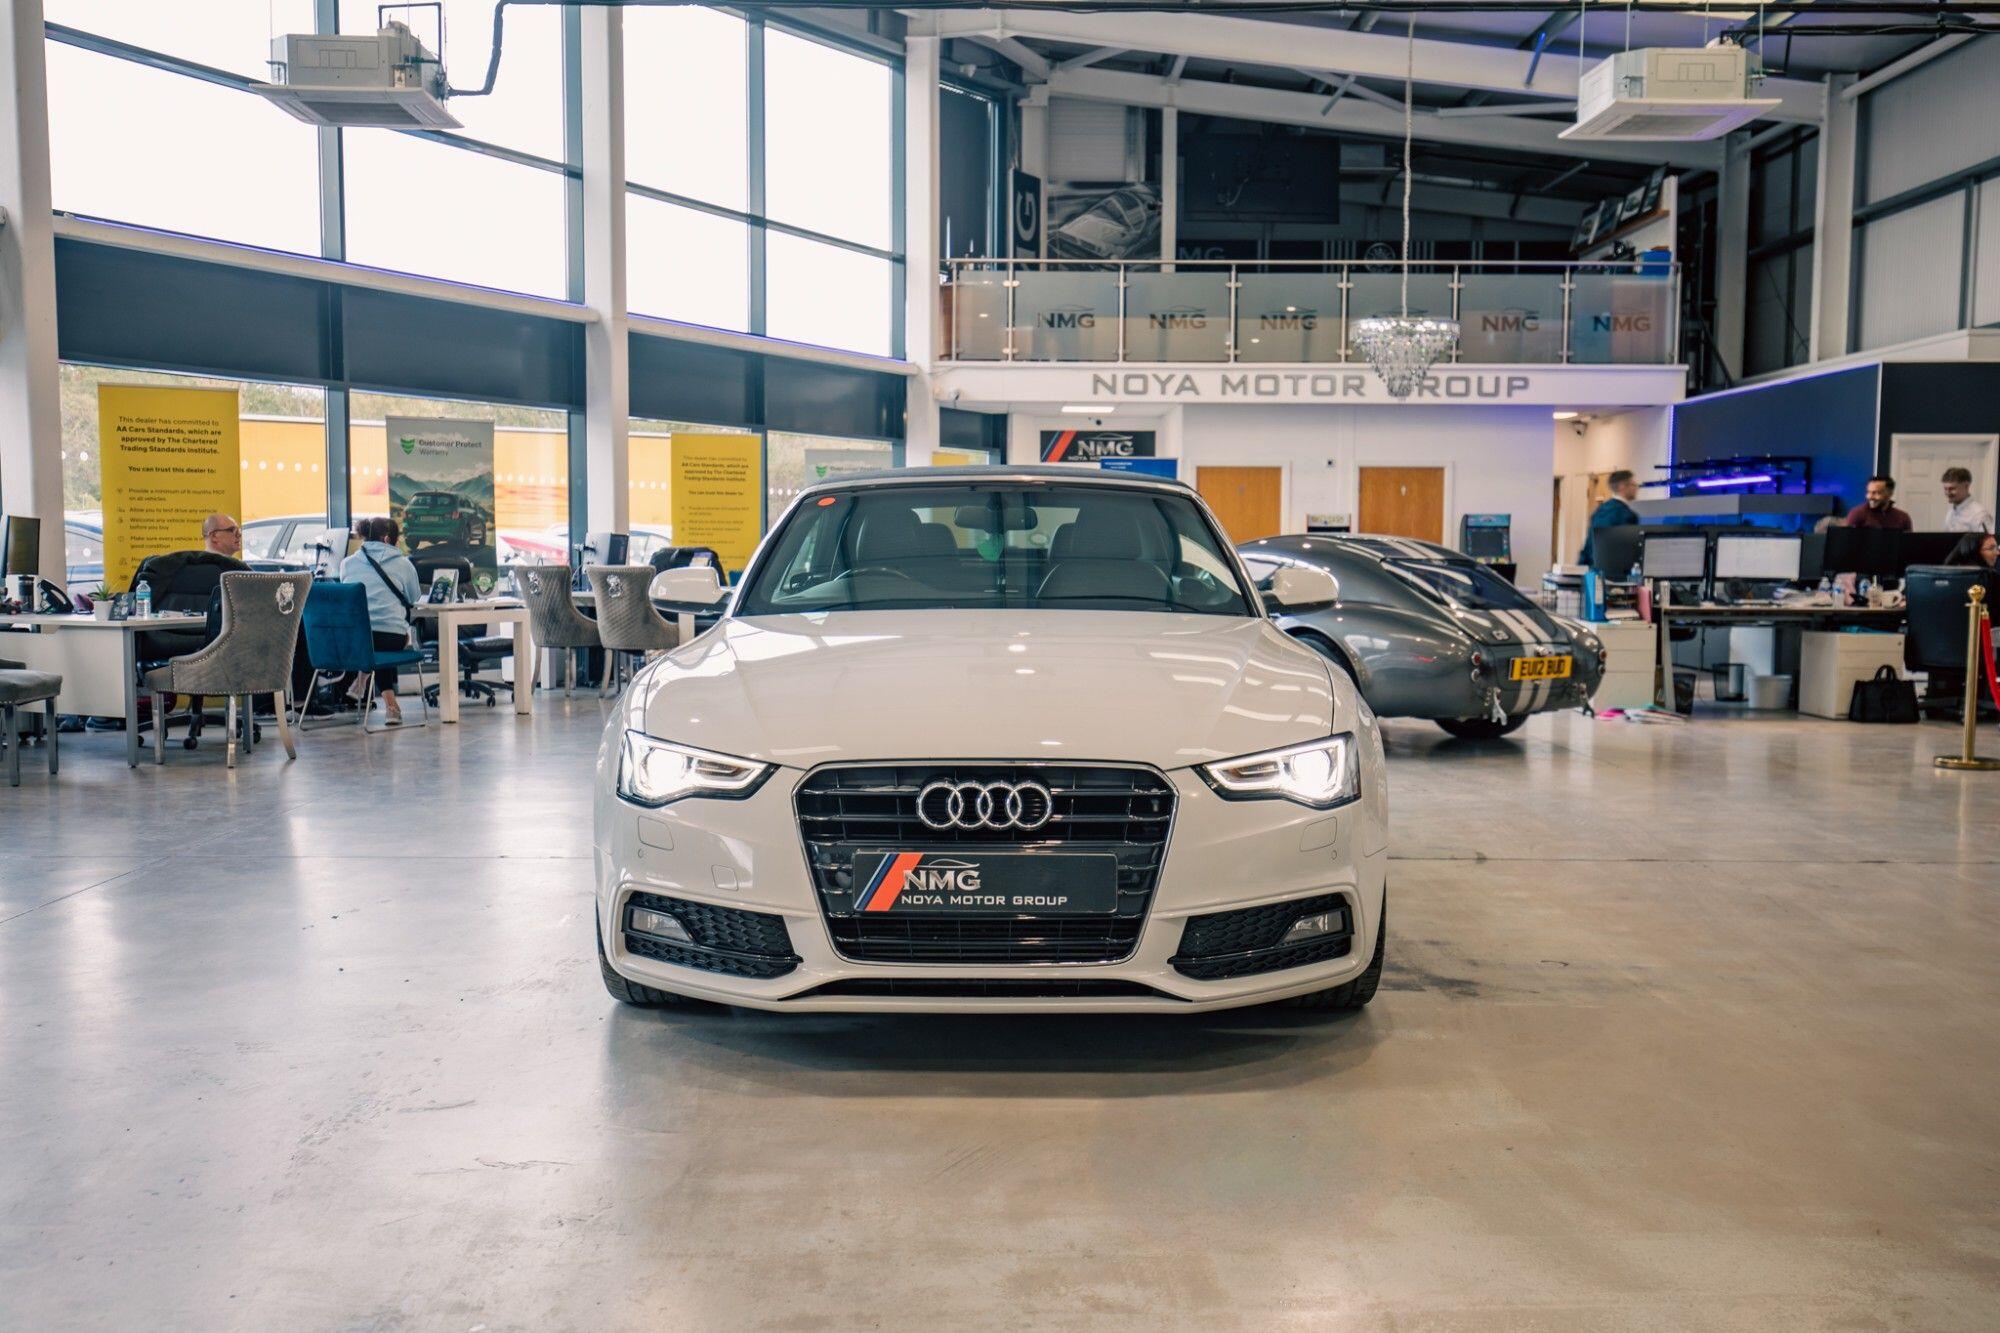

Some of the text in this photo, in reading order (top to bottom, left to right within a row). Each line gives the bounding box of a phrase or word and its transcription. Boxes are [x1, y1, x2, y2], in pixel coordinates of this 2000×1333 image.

[1149, 313, 1206, 329] NMG
[1260, 314, 1317, 330] NMG
[1482, 315, 1540, 332] NMG
[1593, 316, 1651, 332] NMG
[1092, 373, 1200, 395] NOYA
[1221, 374, 1366, 396] MOTOR
[135, 416, 157, 424] dealer
[159, 417, 171, 425] has
[173, 418, 210, 426] committed
[157, 436, 165, 444] by
[1078, 440, 1134, 456] NMG
[120, 445, 147, 453] Trading
[1521, 660, 1545, 676] EU12
[903, 870, 981, 891] NMG
[901, 895, 1068, 905] NOYA MOTOR GROUP
